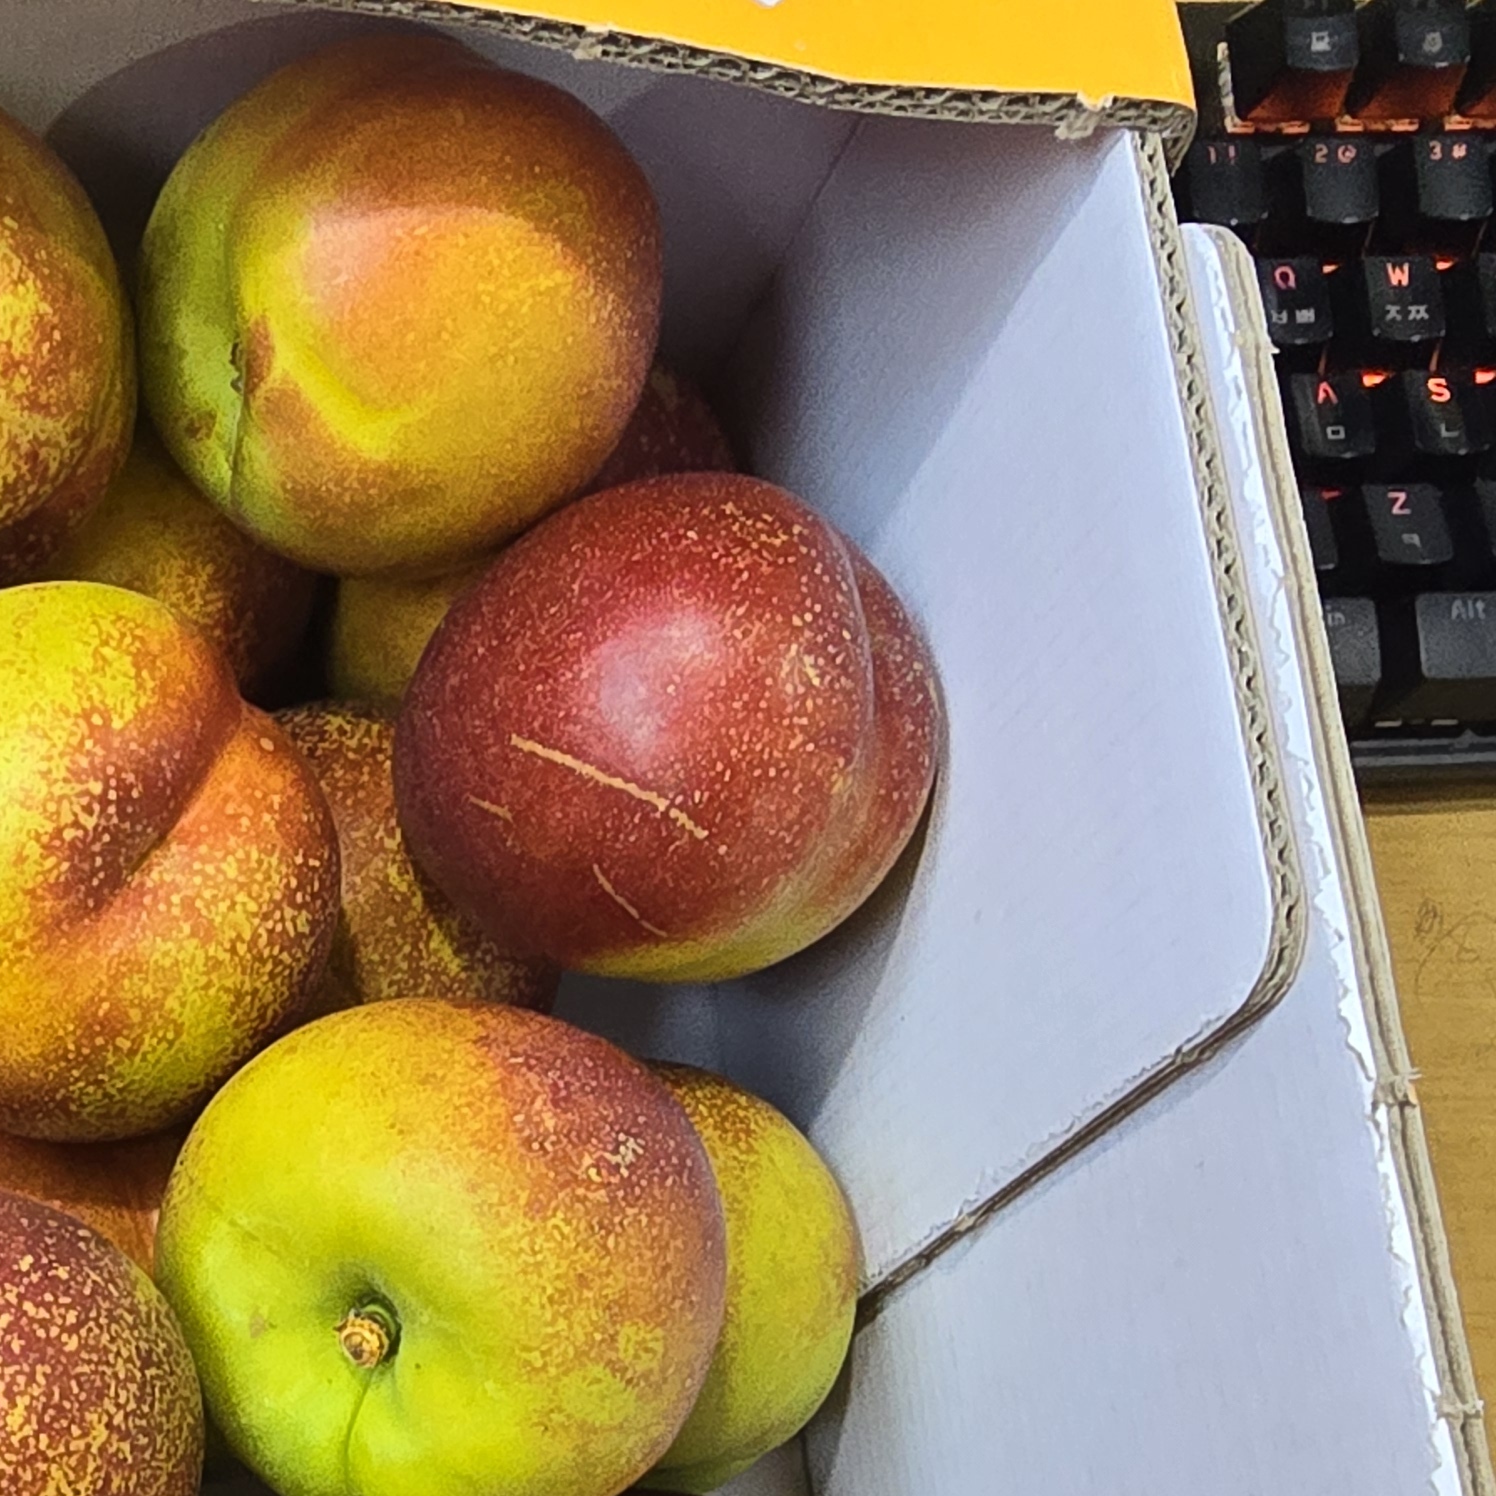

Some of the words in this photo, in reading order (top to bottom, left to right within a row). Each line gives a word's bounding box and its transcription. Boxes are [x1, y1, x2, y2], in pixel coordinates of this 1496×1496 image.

[1314, 144, 1328, 163] 2
[1429, 141, 1443, 160] 3
[1274, 265, 1297, 289] Q
[1386, 262, 1410, 286] W
[1316, 380, 1339, 404] A
[1426, 377, 1452, 403] S
[1387, 490, 1412, 515] Z
[1450, 599, 1487, 620] Alt
